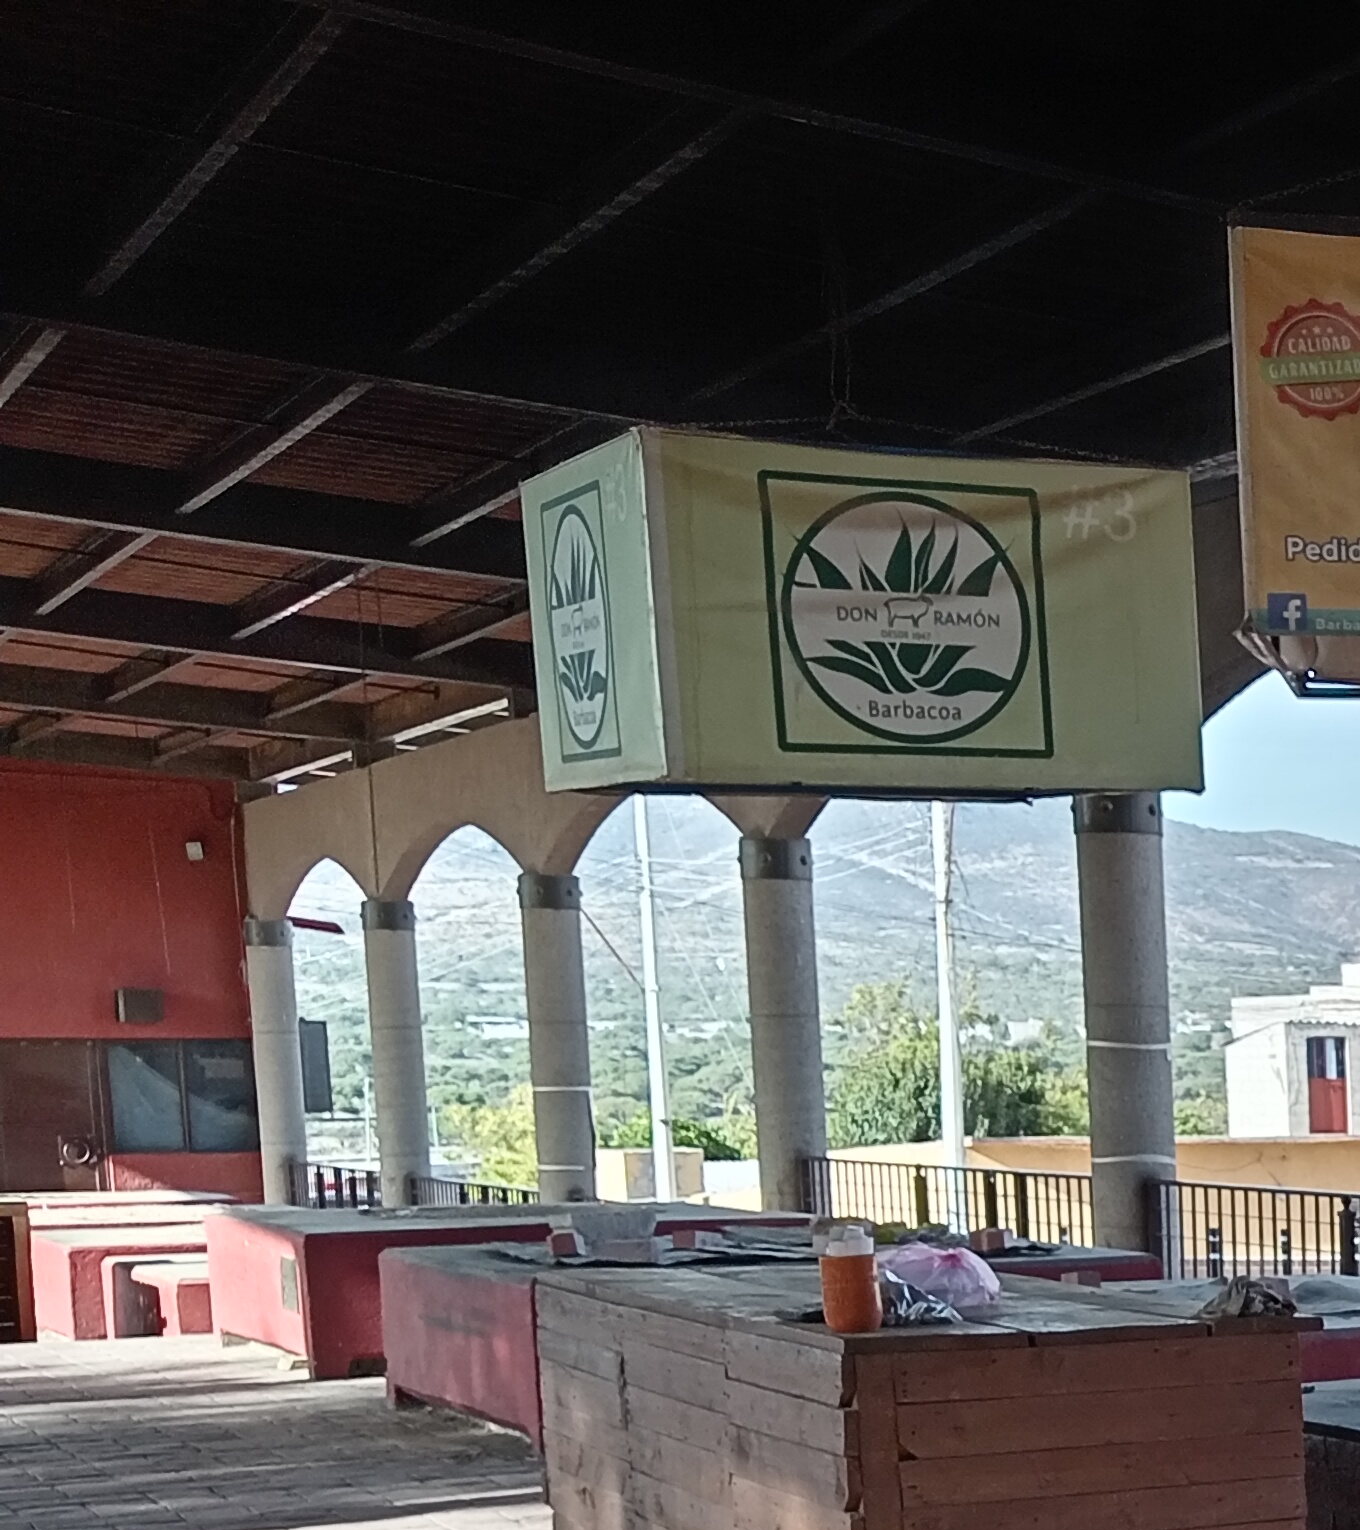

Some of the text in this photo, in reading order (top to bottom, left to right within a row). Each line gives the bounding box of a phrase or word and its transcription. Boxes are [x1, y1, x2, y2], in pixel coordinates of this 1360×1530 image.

[1288, 335, 1351, 353] CALIDAD
[1309, 387, 1344, 400] 100%
[1063, 488, 1137, 542] #3
[836, 606, 1000, 628] DON RAMÓN
[868, 700, 962, 721] Barbacoa
